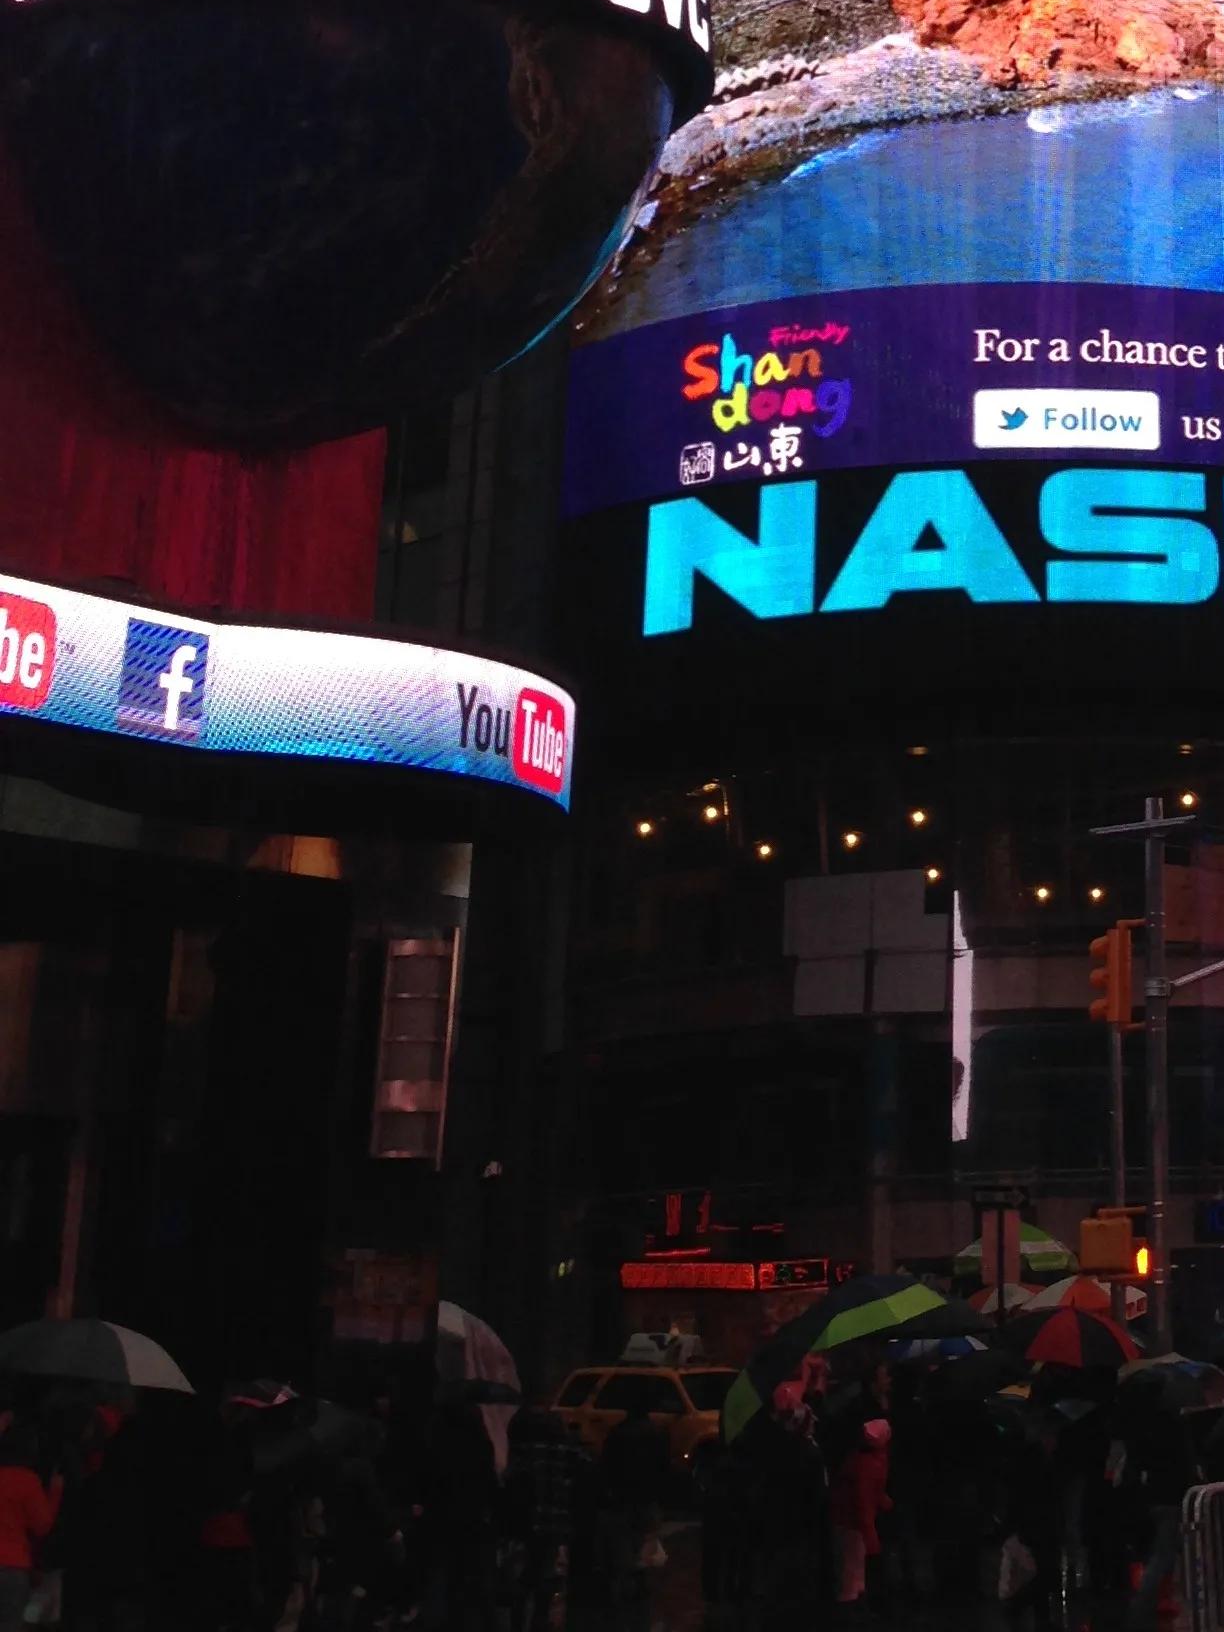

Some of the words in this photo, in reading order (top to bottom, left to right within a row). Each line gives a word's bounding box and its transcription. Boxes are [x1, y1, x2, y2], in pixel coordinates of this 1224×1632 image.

[682, 332, 823, 401] Shan
[973, 328, 1040, 363] For
[1047, 337, 1072, 363] a
[1080, 328, 1208, 369] chance
[711, 381, 855, 438] dong
[1043, 407, 1143, 432] Follow
[1181, 415, 1222, 441] us
